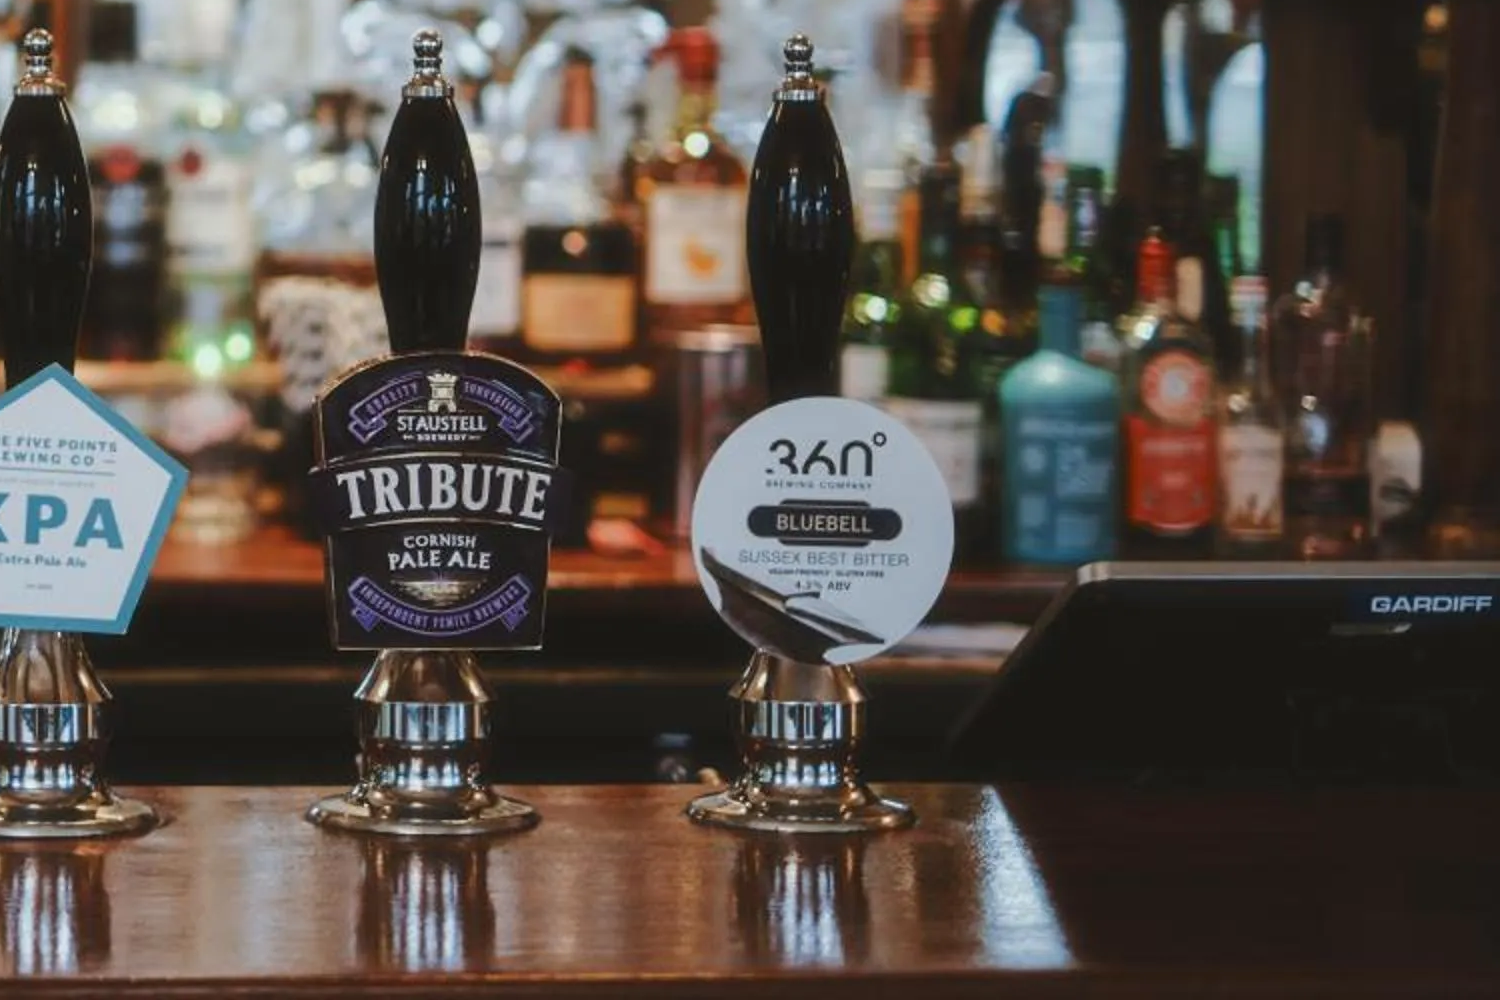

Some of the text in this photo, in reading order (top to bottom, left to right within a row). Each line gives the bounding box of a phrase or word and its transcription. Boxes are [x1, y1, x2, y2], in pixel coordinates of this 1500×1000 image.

[16, 436, 52, 449] FIVE
[57, 439, 118, 453] POINTS
[70, 454, 96, 467] CO
[335, 462, 552, 521] TRIBUTE
[776, 513, 873, 533] BLUEBELL
[403, 534, 478, 549] CORNISH
[34, 554, 62, 567] Pale
[66, 556, 88, 569] Ale
[388, 550, 492, 571] PALE ALE
[738, 549, 910, 567] SUSSEX BEST BITTER
[827, 580, 851, 592] ABV
[1370, 595, 1493, 613] GARDIFF
